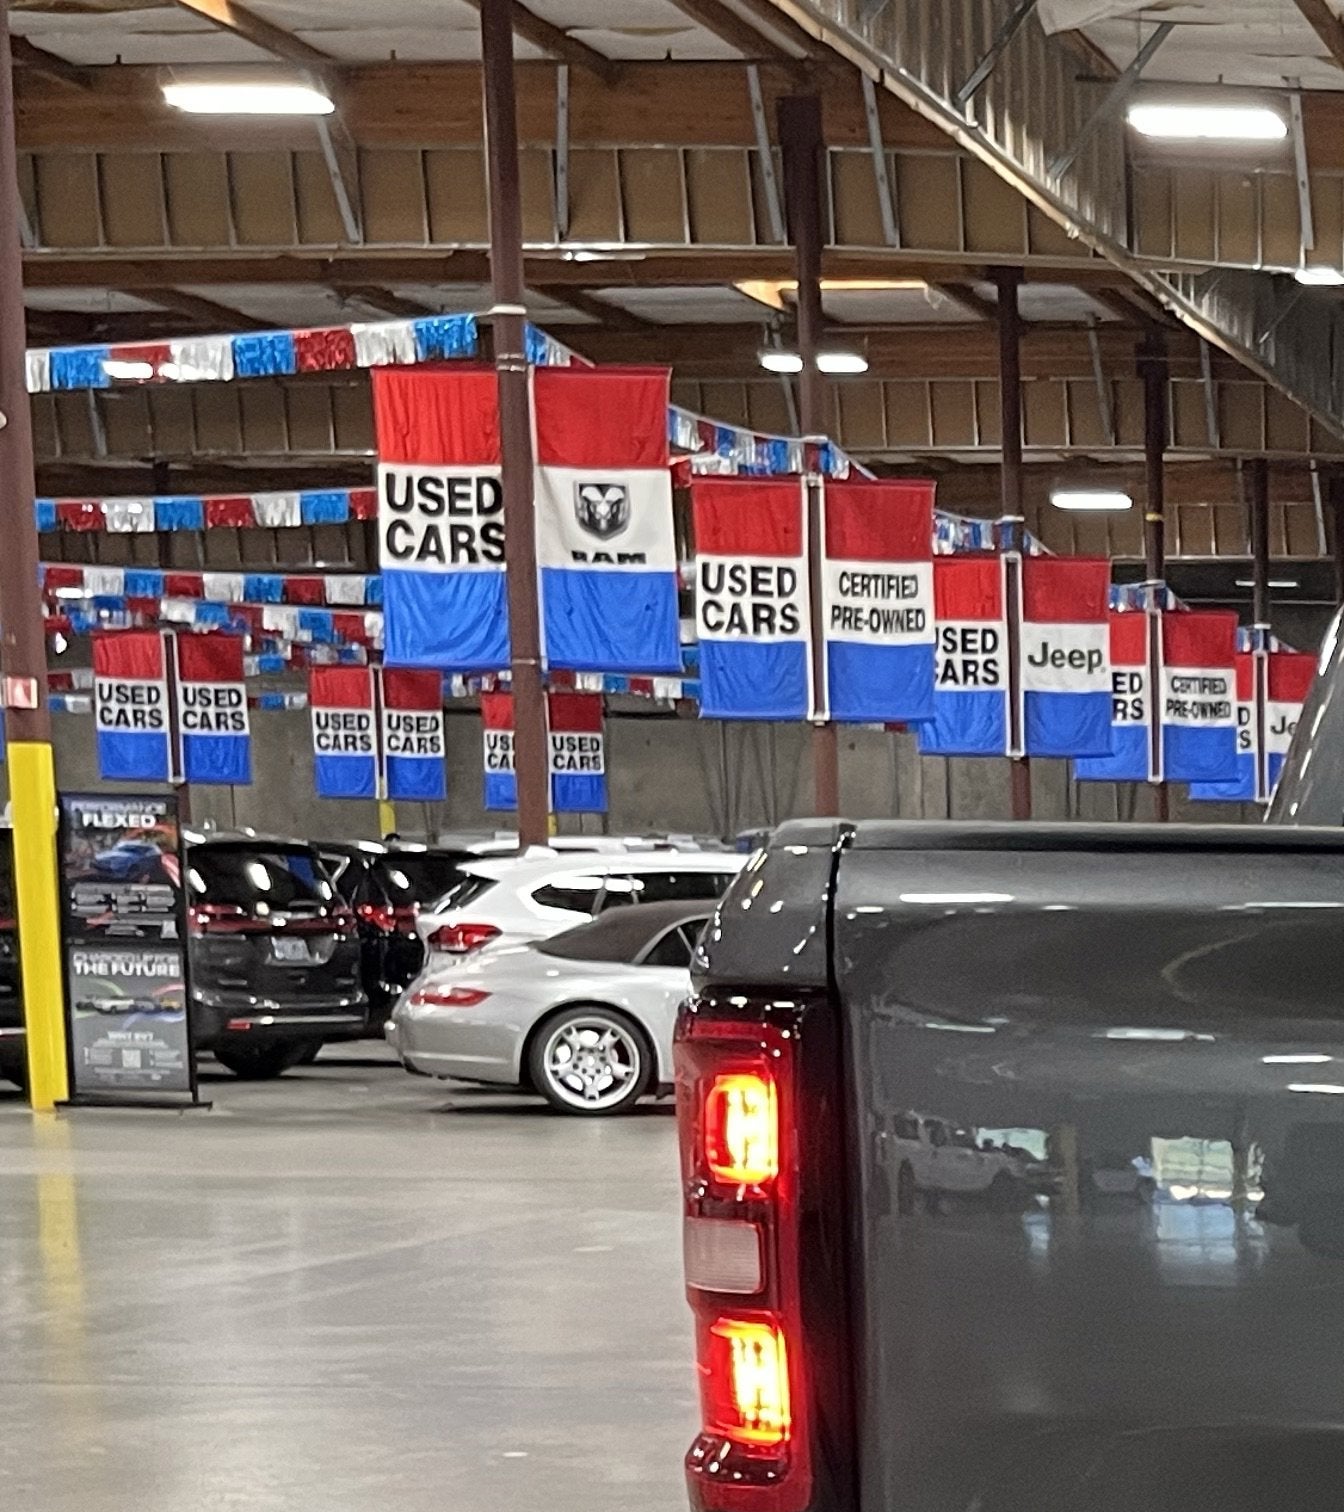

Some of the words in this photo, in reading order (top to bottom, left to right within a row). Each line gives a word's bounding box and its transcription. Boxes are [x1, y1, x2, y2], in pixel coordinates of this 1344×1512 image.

[386, 473, 503, 517] USED
[386, 519, 505, 564] CARS
[702, 562, 797, 598] USED
[838, 571, 918, 600] CERTIFIED
[702, 600, 800, 635] CARS
[831, 604, 926, 634] PRE-OWNED
[935, 627, 999, 654] SED
[1027, 641, 1103, 674] Jeep
[935, 658, 1000, 686] ARS
[1111, 672, 1143, 694] ED
[98, 683, 161, 705] USED
[1171, 675, 1227, 694] CERTIFIED
[182, 686, 242, 708] USED
[99, 706, 163, 728] CARS
[1112, 699, 1144, 721] RS
[1166, 699, 1231, 719] PRE-OWNED
[182, 710, 245, 731] CARS
[316, 712, 370, 731] USED
[387, 713, 440, 733] USED
[316, 733, 372, 751] CARS
[387, 734, 441, 753] CARS
[486, 734, 515, 751] US
[552, 735, 600, 752] USED
[487, 753, 515, 769] CA
[553, 754, 601, 770] CARS
[82, 812, 157, 829] FLEXED
[73, 961, 109, 976] THE
[111, 961, 180, 977] FUTURE
